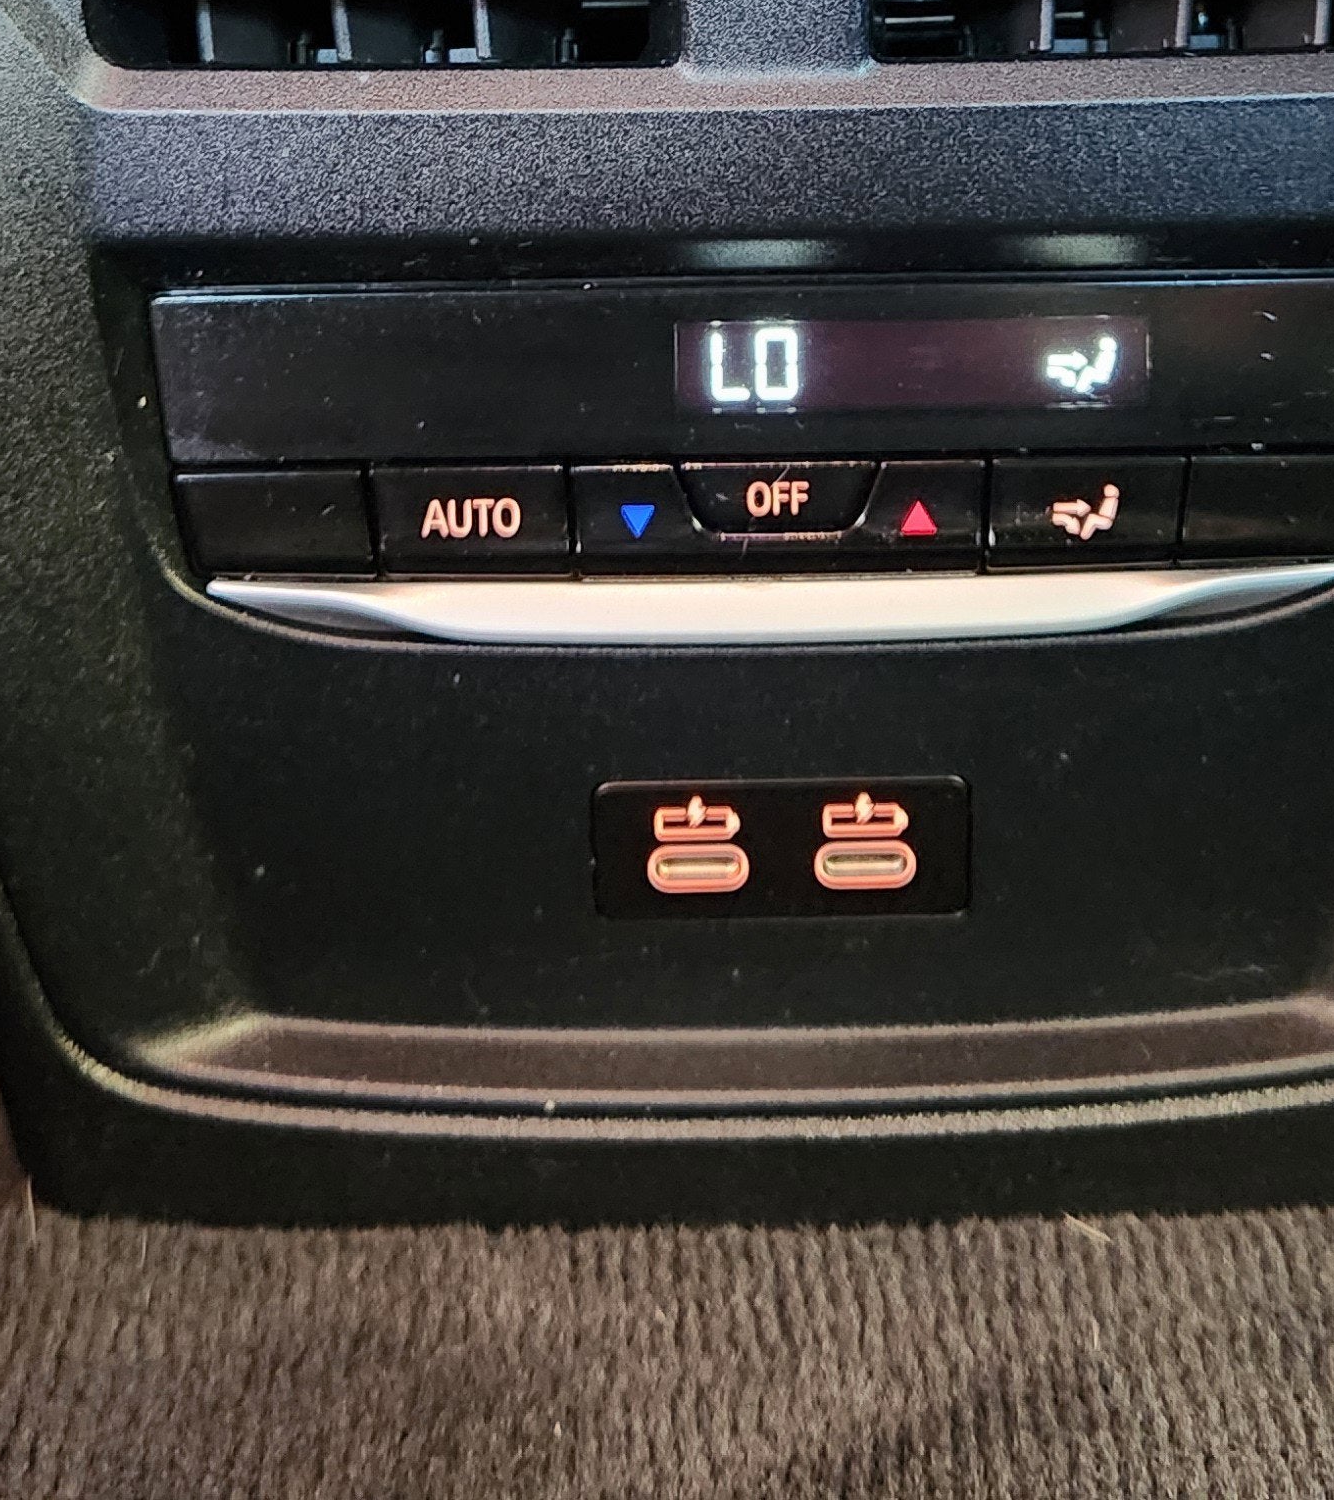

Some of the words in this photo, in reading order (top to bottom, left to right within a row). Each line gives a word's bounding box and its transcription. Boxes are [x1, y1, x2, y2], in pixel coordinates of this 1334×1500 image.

[708, 325, 800, 403] LO
[422, 497, 522, 539] AUTO
[746, 480, 810, 518] OFF
